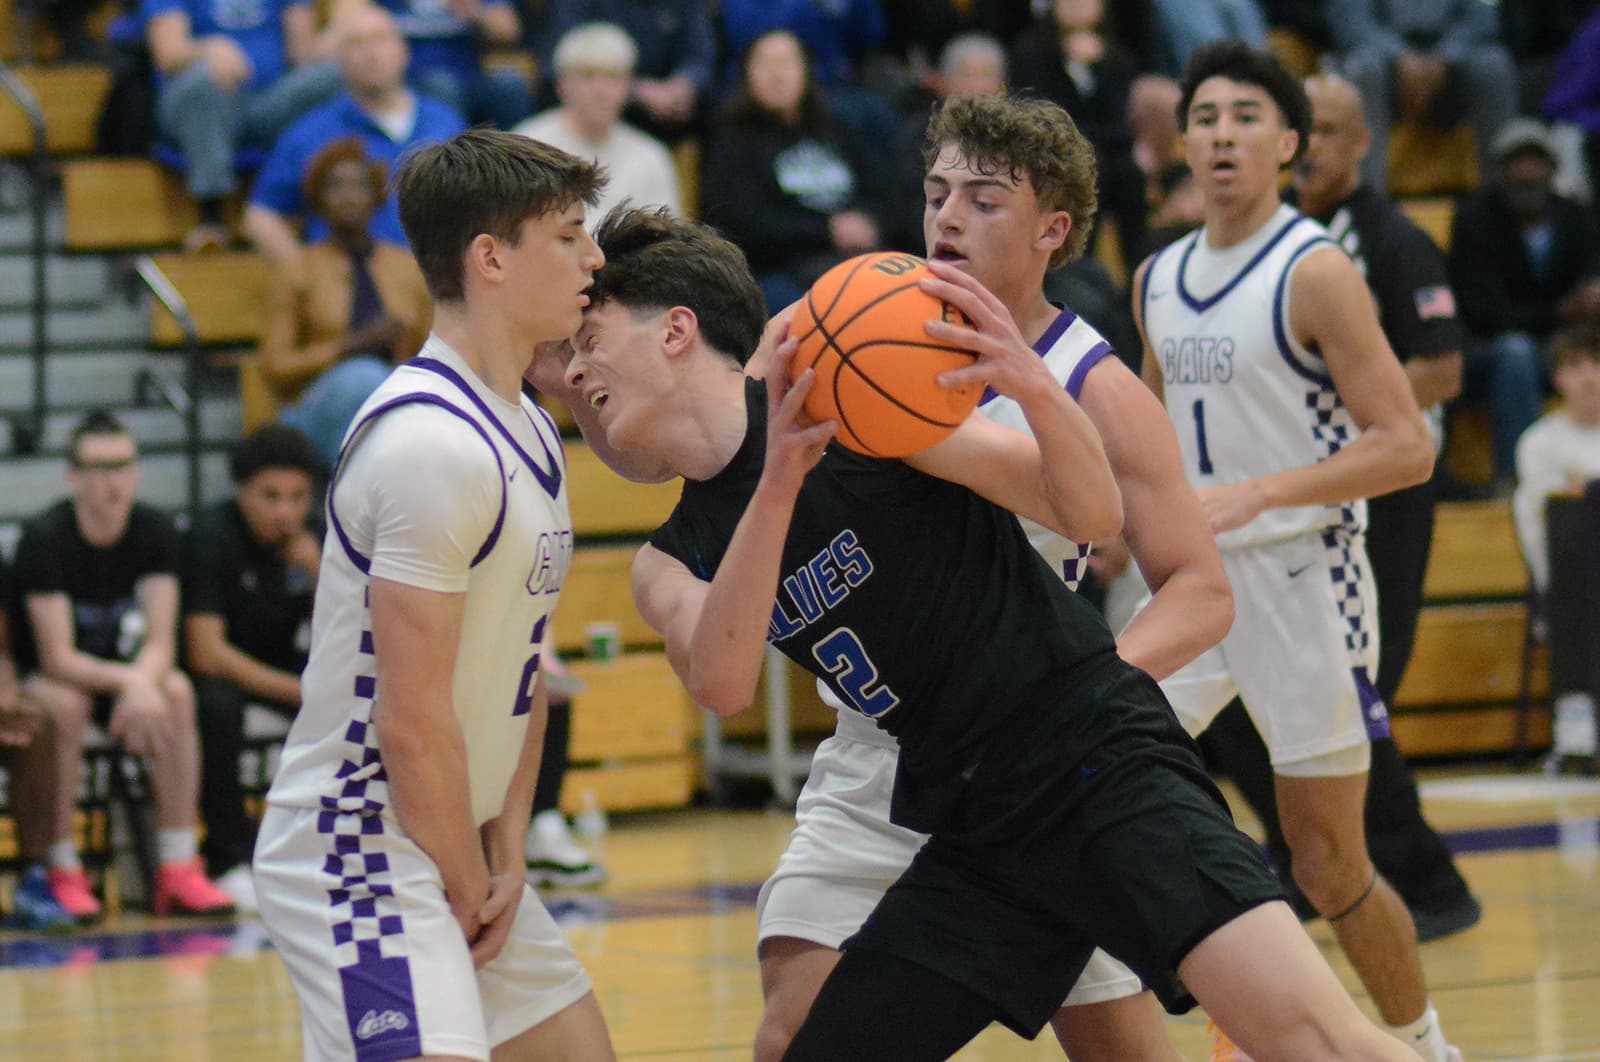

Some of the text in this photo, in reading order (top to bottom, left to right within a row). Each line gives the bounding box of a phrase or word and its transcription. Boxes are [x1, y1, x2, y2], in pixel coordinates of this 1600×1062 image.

[1162, 336, 1235, 385] CATS
[1193, 398, 1214, 475] 1
[768, 529, 874, 641] LVES
[812, 626, 900, 717] 2
